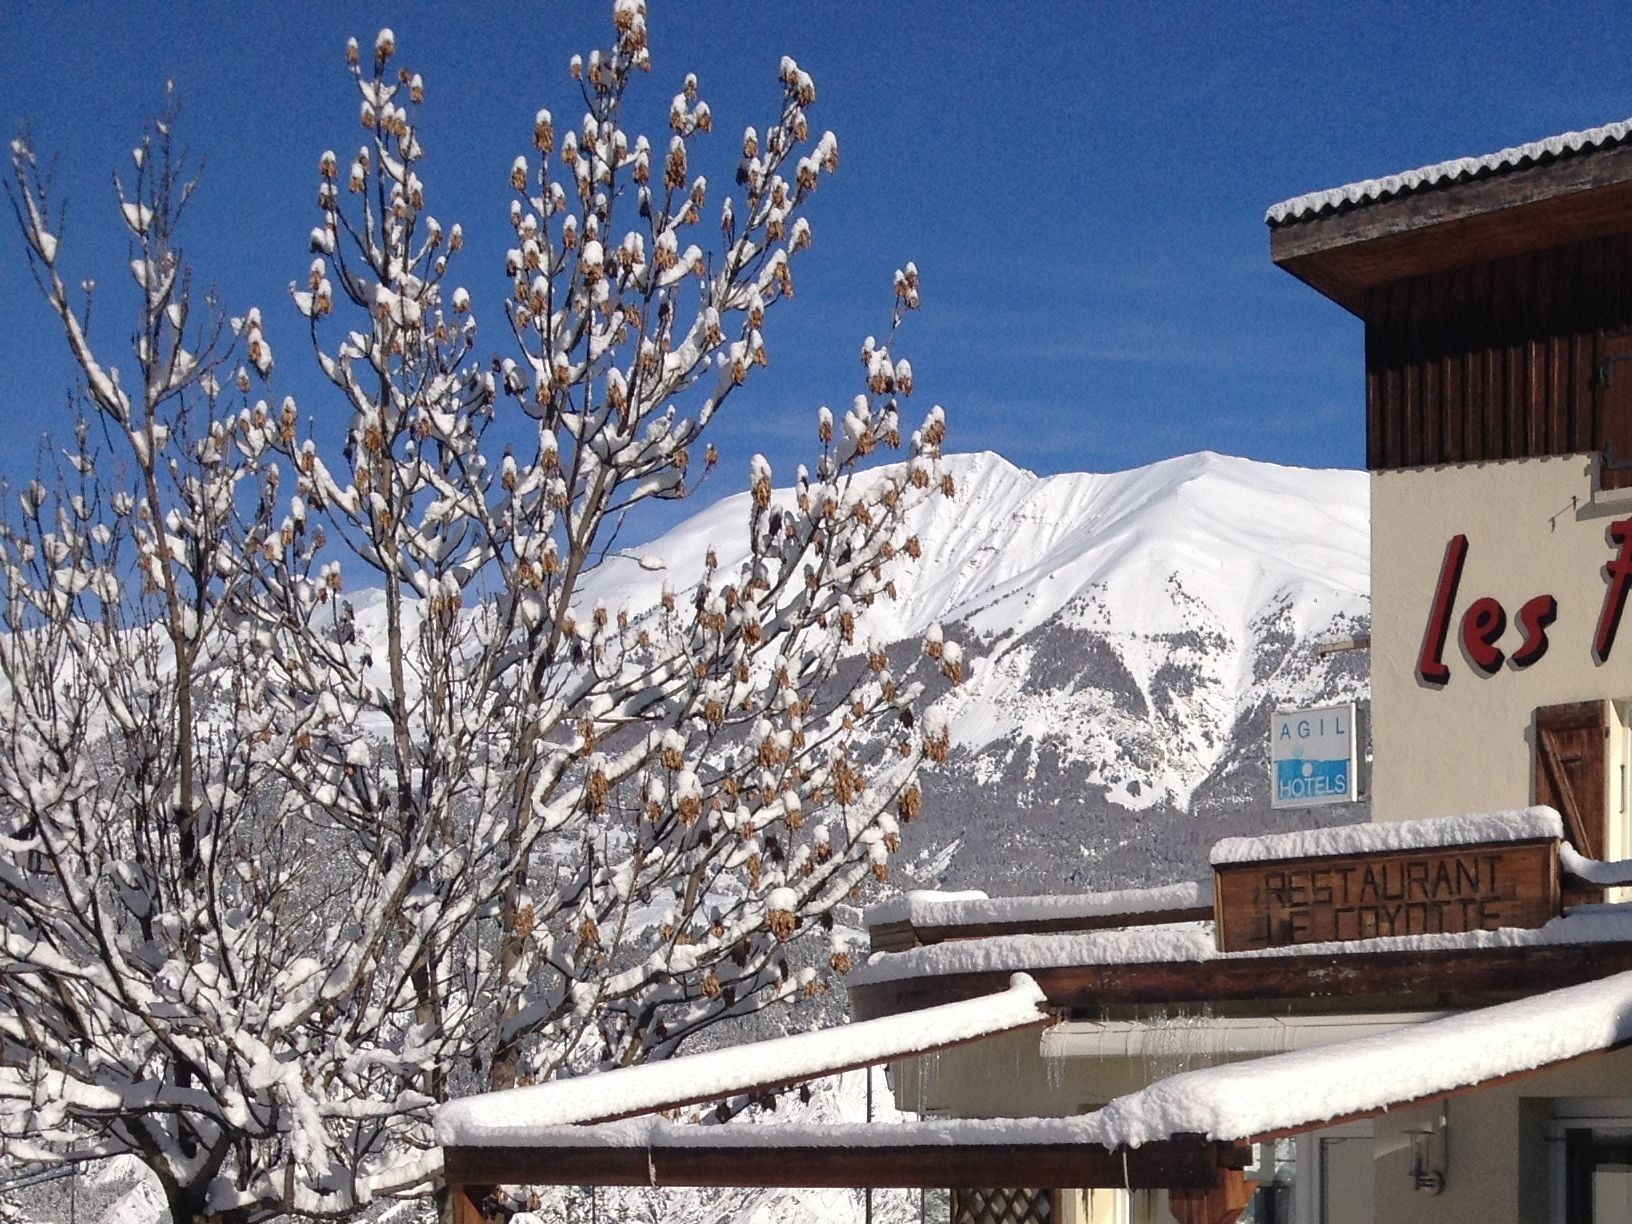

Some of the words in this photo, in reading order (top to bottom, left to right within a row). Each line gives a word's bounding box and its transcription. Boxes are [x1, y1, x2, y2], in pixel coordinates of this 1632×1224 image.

[1417, 534, 1557, 690] les
[1280, 717, 1345, 741] AGIL
[1280, 774, 1346, 798] HOTELS
[1264, 856, 1501, 906] RESTAURANT
